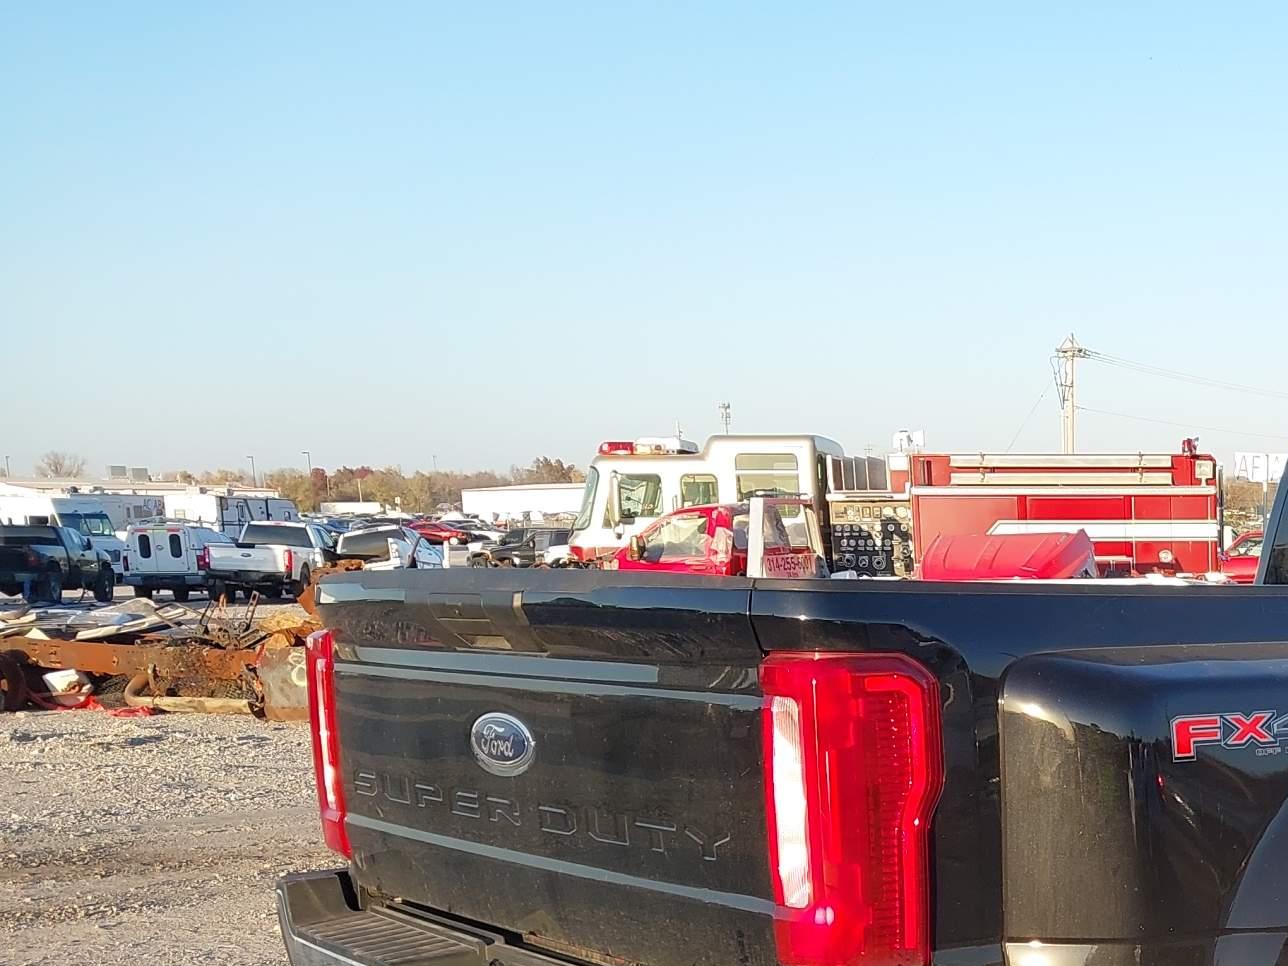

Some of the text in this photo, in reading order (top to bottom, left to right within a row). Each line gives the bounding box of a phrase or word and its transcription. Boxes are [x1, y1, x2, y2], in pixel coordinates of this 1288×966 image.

[481, 723, 514, 757] Ford
[354, 769, 731, 861] SUPER DUTY
